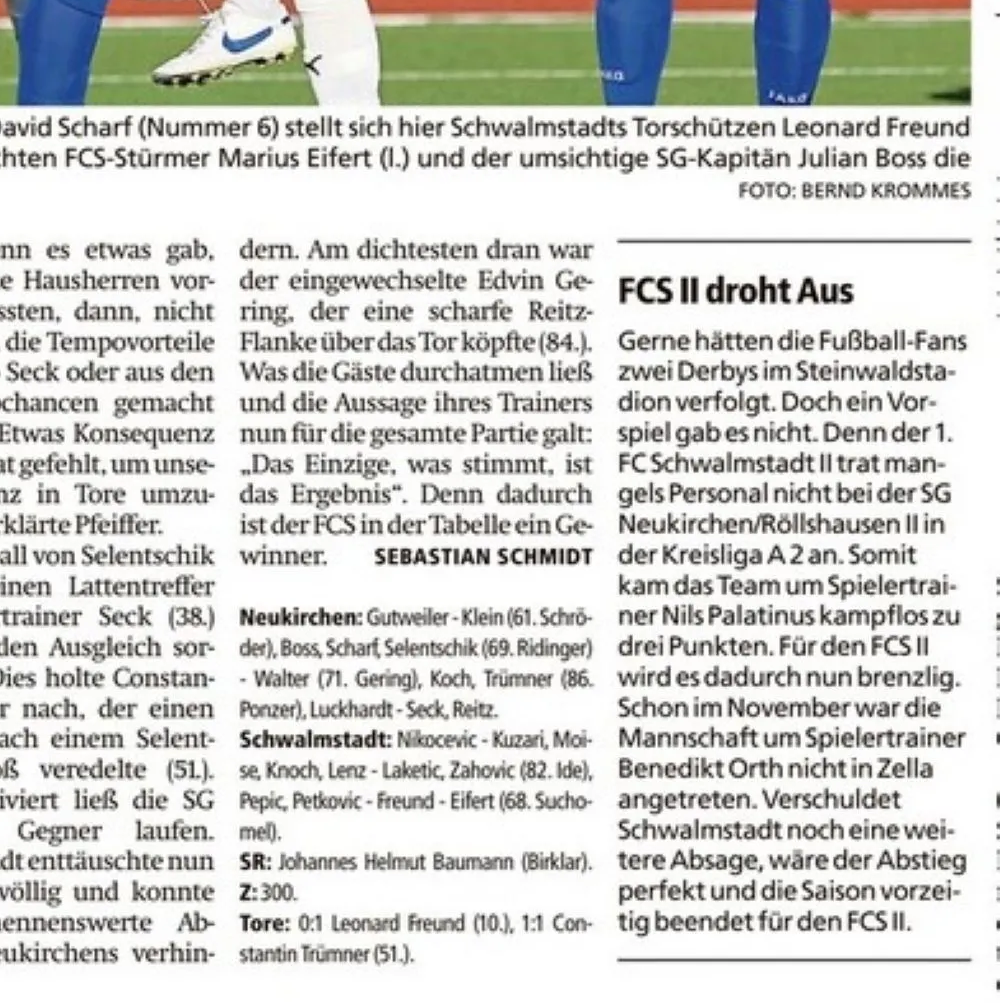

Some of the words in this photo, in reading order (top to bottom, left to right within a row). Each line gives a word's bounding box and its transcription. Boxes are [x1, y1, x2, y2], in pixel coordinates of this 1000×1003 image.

[58, 114, 133, 138] Scharf
[137, 115, 252, 141] (Nummer
[257, 115, 280, 140] 6)
[284, 115, 343, 138] stellt
[348, 115, 393, 138] sich
[399, 115, 446, 139] hier
[450, 115, 628, 138] Schwalmstadts
[631, 115, 776, 138] Torschützen
[782, 115, 881, 138] Leonard
[886, 115, 970, 138] Freund
[65, 146, 211, 169] FCS-Stürmer
[218, 146, 300, 169] Marius
[307, 145, 372, 169] Eifert
[379, 145, 410, 172] (l.)
[417, 146, 465, 169] und
[471, 146, 513, 169] der
[519, 146, 649, 175] umsichtige
[656, 146, 791, 173] SG-Kapitän
[797, 146, 868, 169] Julian
[875, 147, 927, 169] Boss
[933, 145, 972, 169] die
[739, 181, 796, 200] FOTO:
[801, 181, 867, 200] BERND
[871, 181, 972, 200] KROMMES
[239, 269, 280, 291] der
[288, 268, 468, 297] eingewechselte
[478, 268, 545, 291] Edvin
[555, 270, 593, 292] Ge-
[618, 275, 674, 305] FCS
[680, 275, 700, 305] II
[705, 274, 792, 305] droht
[796, 276, 855, 305] Aus
[618, 329, 692, 352] Gerne
[695, 329, 774, 352] hätten
[777, 329, 815, 352] die
[819, 328, 968, 352] Fußball-Fans
[113, 391, 214, 419] gemacht
[239, 544, 328, 567] winner.
[374, 547, 491, 566] SEBASTIAN
[496, 547, 594, 566] SCHMIDT
[99, 604, 152, 627] Seck
[168, 606, 215, 631] (38.)
[239, 606, 363, 627] Neukirchen:
[366, 607, 450, 627] Gutweiler
[461, 607, 504, 626] Klein
[506, 607, 537, 629] (61.
[539, 607, 593, 627] Schrö-
[618, 757, 725, 779] Benedikt
[728, 756, 784, 779] Orth
[787, 756, 848, 779] nicht
[851, 757, 873, 779] in
[876, 756, 934, 779] Zella
[618, 790, 758, 815] angetreten.
[761, 787, 901, 810] Verschuldet
[17, 820, 103, 847] Gegner
[135, 818, 215, 842] laufen.
[239, 851, 272, 871] SR:
[278, 851, 358, 871] Johannes
[364, 851, 427, 871] Helmut
[433, 851, 514, 871] Baumann
[521, 851, 593, 873] (Birklar).
[239, 913, 291, 933] Tore:
[298, 913, 322, 932] 0:1
[331, 913, 401, 932] Leonard
[407, 912, 466, 932] Freund
[473, 912, 514, 935] (10.),
[522, 914, 543, 932] 1:1
[552, 912, 593, 932] Con-
[131, 941, 216, 963] verhin-
